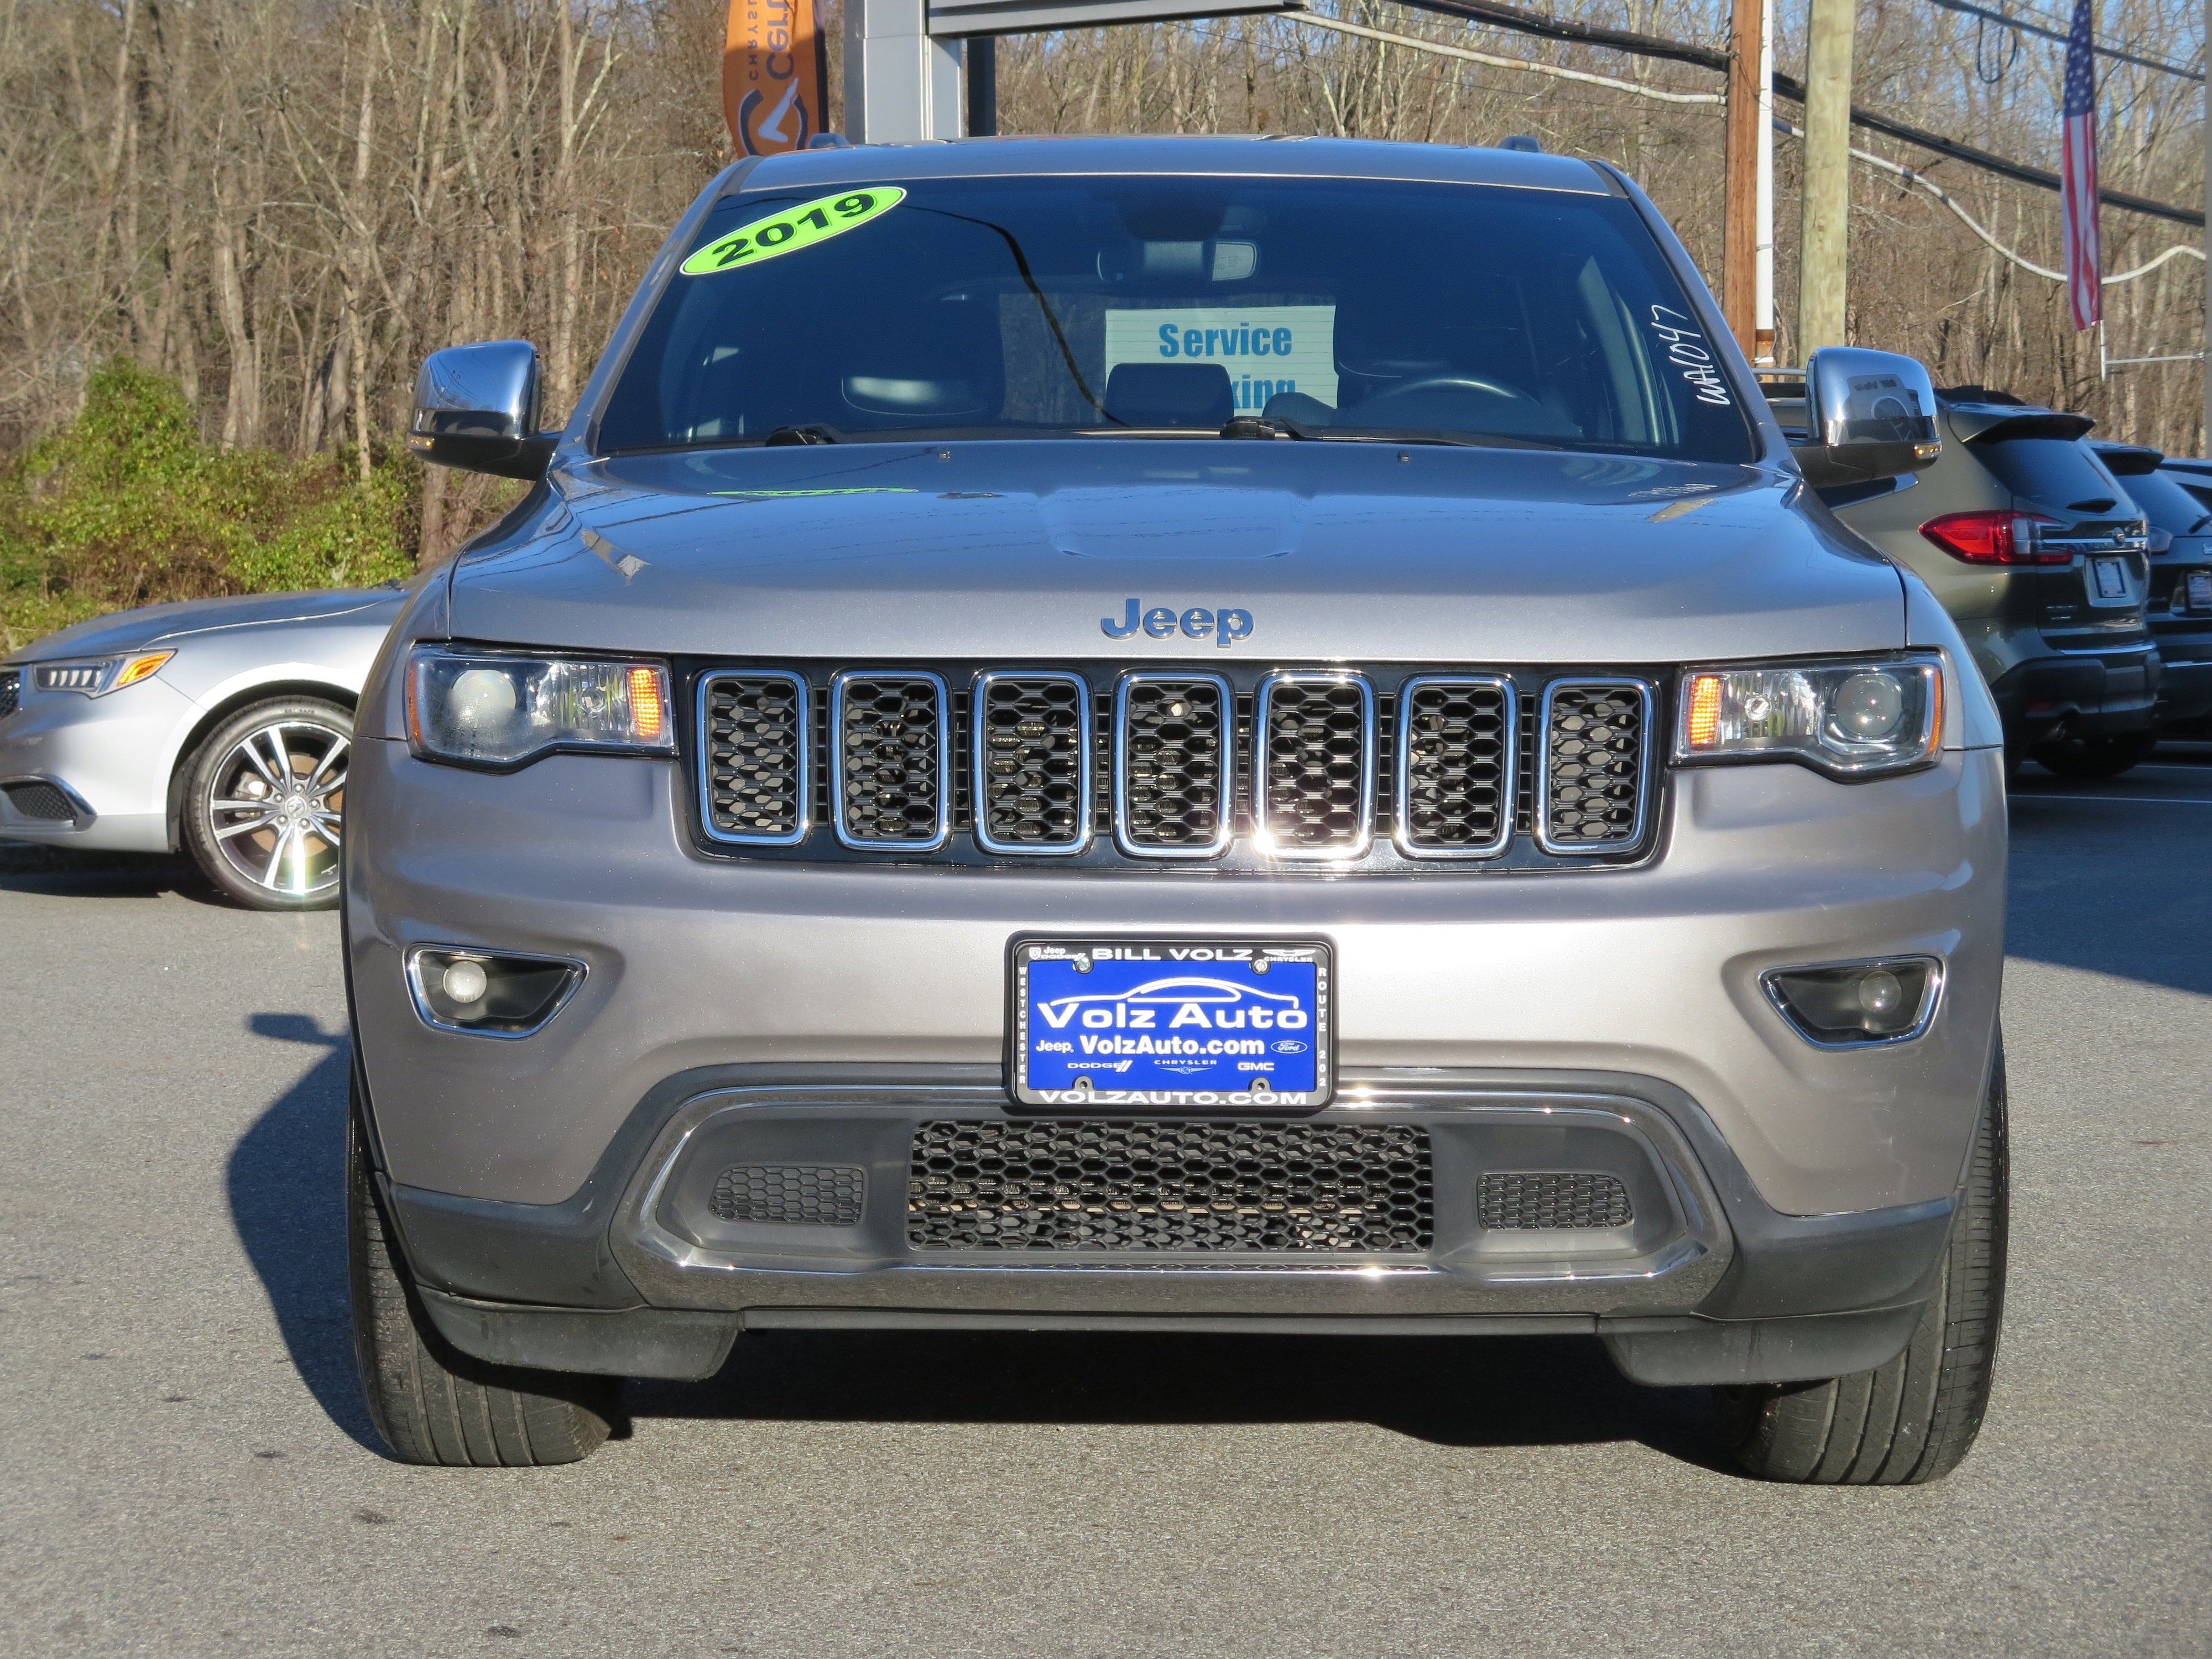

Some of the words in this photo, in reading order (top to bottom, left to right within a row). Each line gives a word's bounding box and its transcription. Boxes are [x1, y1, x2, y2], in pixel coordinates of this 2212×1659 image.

[712, 193, 877, 268] 2019
[1159, 322, 1293, 358] Service
[1100, 598, 1254, 648] Jeep
[1043, 946, 1066, 955] Jeep
[1092, 948, 1161, 961] BILL
[1168, 948, 1253, 961] VOLZ
[1318, 967, 1327, 1033] ROUTE
[1018, 966, 1027, 1084] WESTCHESTER
[1037, 1003, 1156, 1029] Volz
[1168, 1003, 1308, 1029] Auto
[1079, 1035, 1265, 1055] VolzAuto.com
[1067, 1062, 1123, 1070] DODGE
[1237, 1061, 1275, 1071] GMC
[1318, 1050, 1327, 1087] 202
[1039, 1090, 1307, 1105] VOLZAUTO.COM
